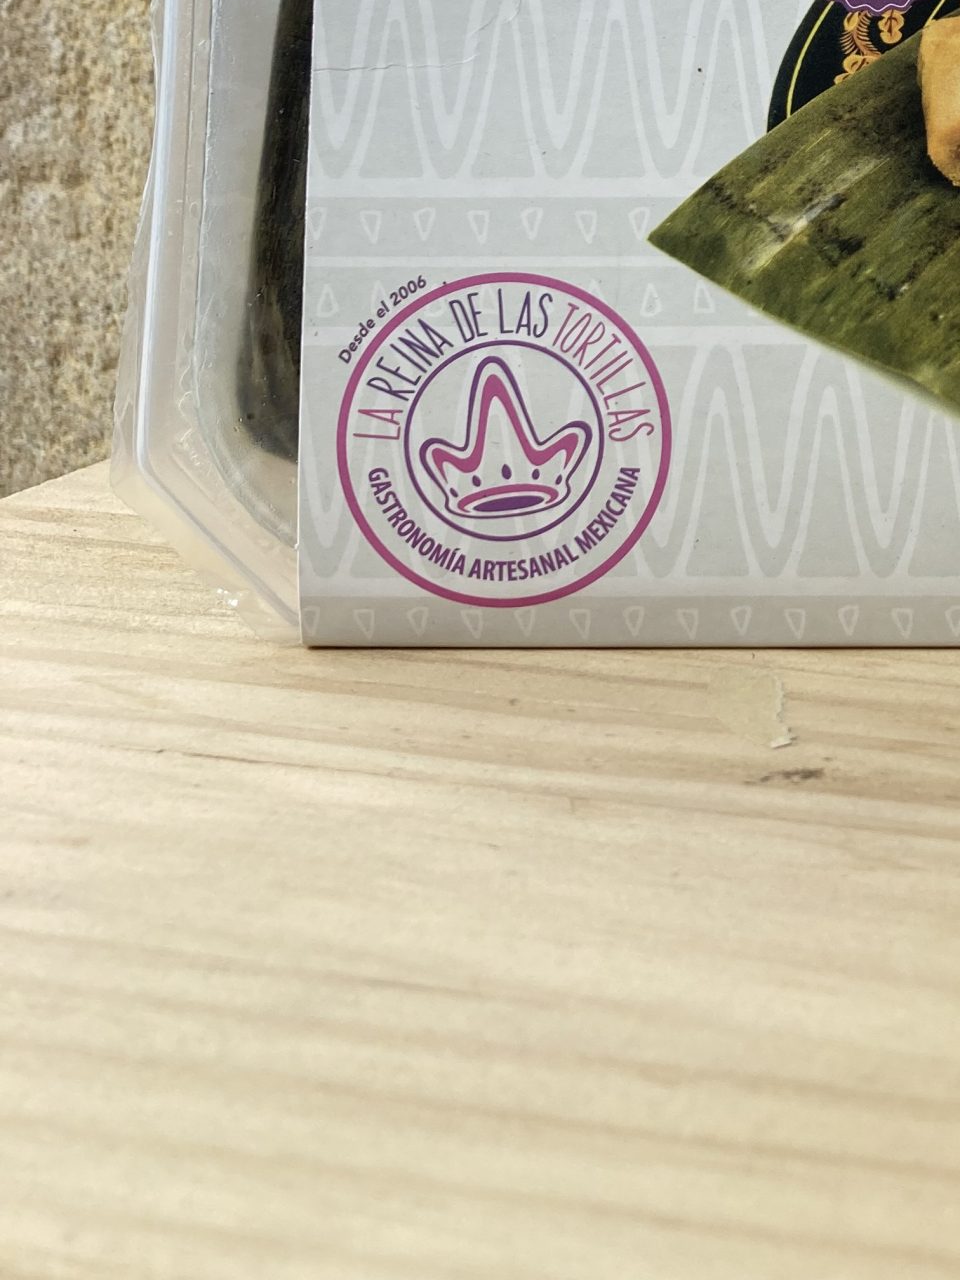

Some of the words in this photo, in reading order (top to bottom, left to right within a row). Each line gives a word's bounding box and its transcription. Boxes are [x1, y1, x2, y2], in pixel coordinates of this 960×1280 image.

[338, 318, 376, 364] Desde
[376, 301, 391, 319] el
[388, 275, 428, 306] 2006
[449, 292, 491, 343] DE
[498, 288, 554, 339] LAS
[366, 318, 455, 402] REINA
[552, 302, 655, 443] TORTILLAS
[353, 407, 404, 441] LA
[367, 466, 466, 577] GASTRONOMÍA
[467, 543, 580, 582] ARTESANAL
[573, 466, 642, 556] MEXICANA
